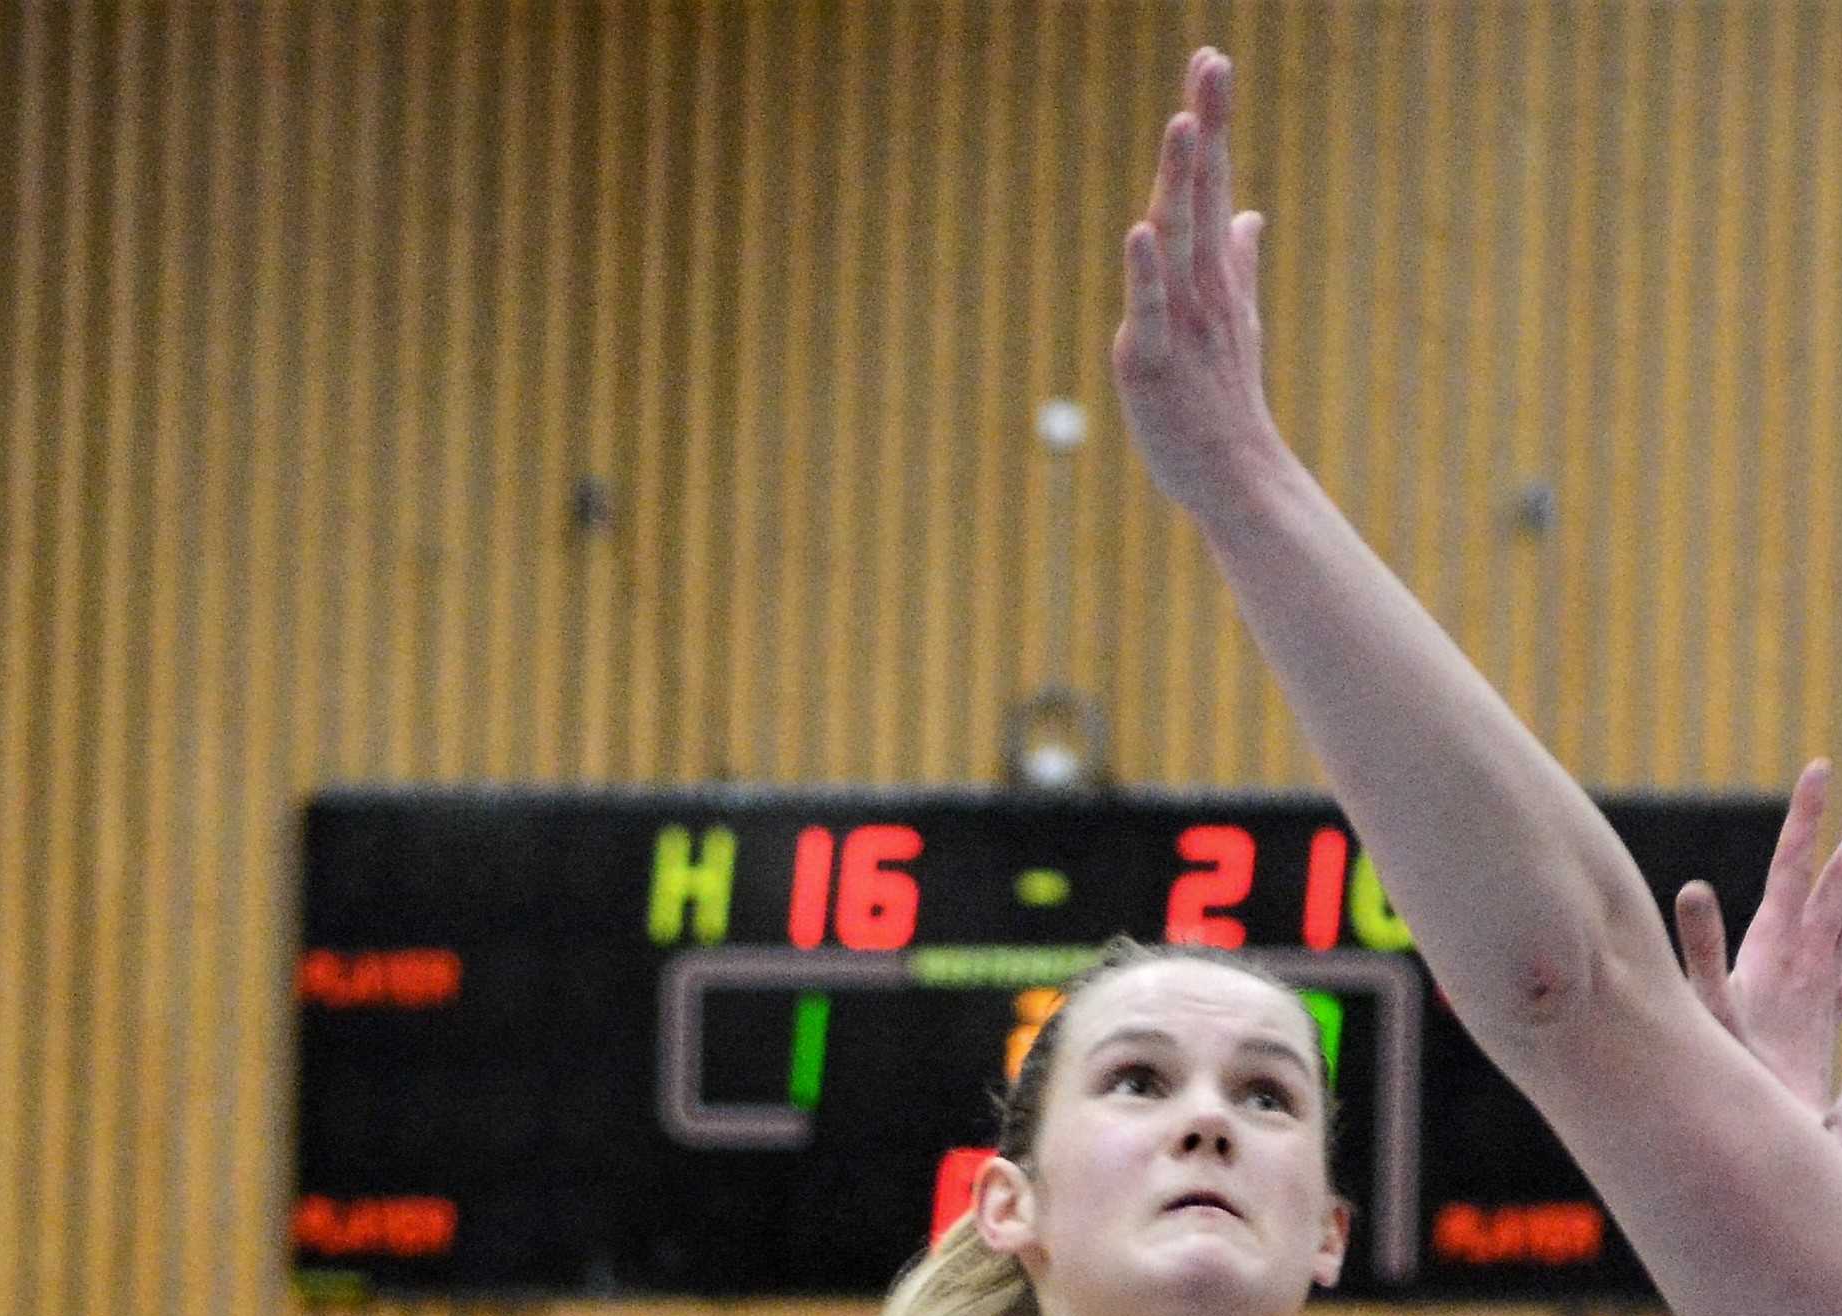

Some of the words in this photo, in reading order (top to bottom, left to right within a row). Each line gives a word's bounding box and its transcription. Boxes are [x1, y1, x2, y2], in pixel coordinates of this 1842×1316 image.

[647, 822, 738, 947] H
[787, 823, 924, 950] 16
[1166, 824, 1347, 951] 21
